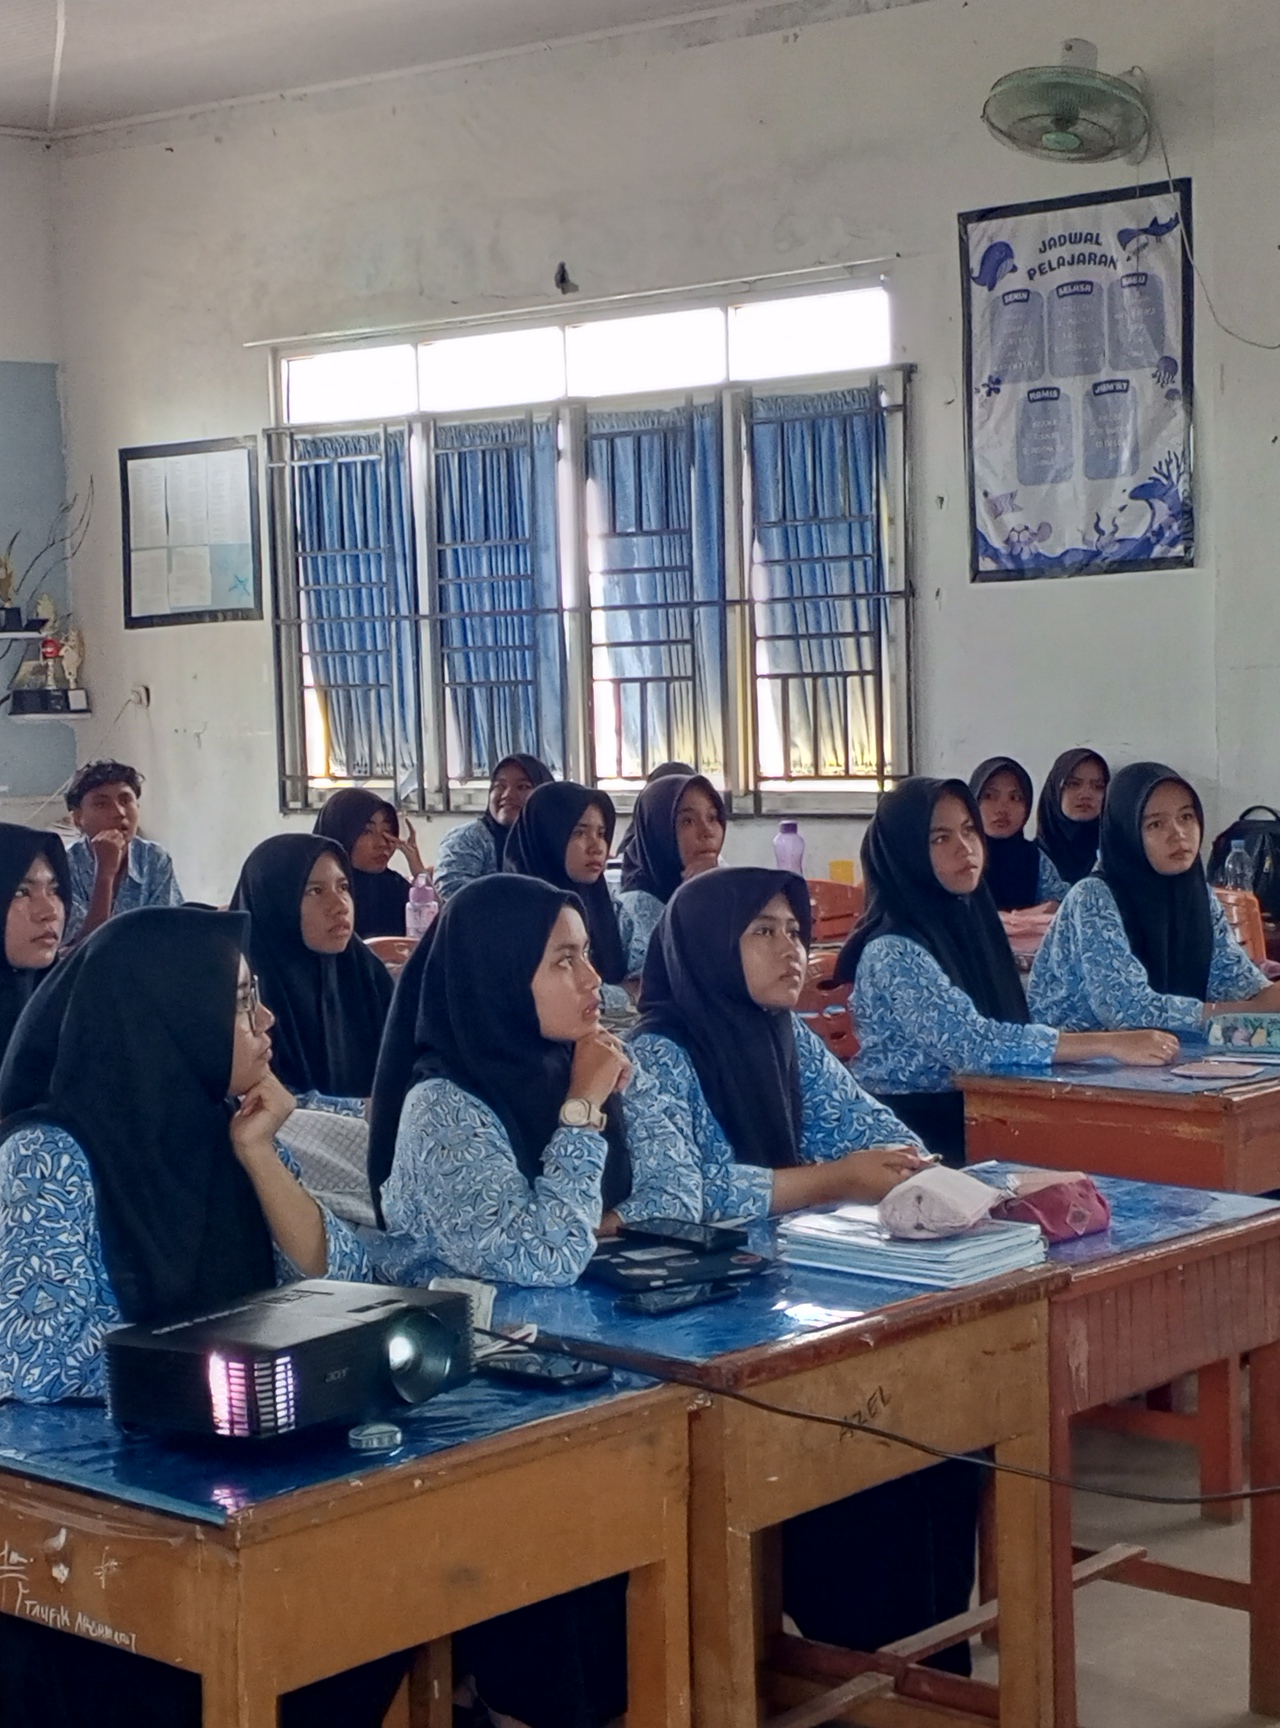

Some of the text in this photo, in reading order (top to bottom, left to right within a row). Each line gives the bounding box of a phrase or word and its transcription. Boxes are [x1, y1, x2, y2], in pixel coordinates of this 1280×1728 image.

[1038, 231, 1102, 254] JADWAL
[1026, 252, 1119, 281] PELAJARAN
[1029, 389, 1058, 401] KAMIS
